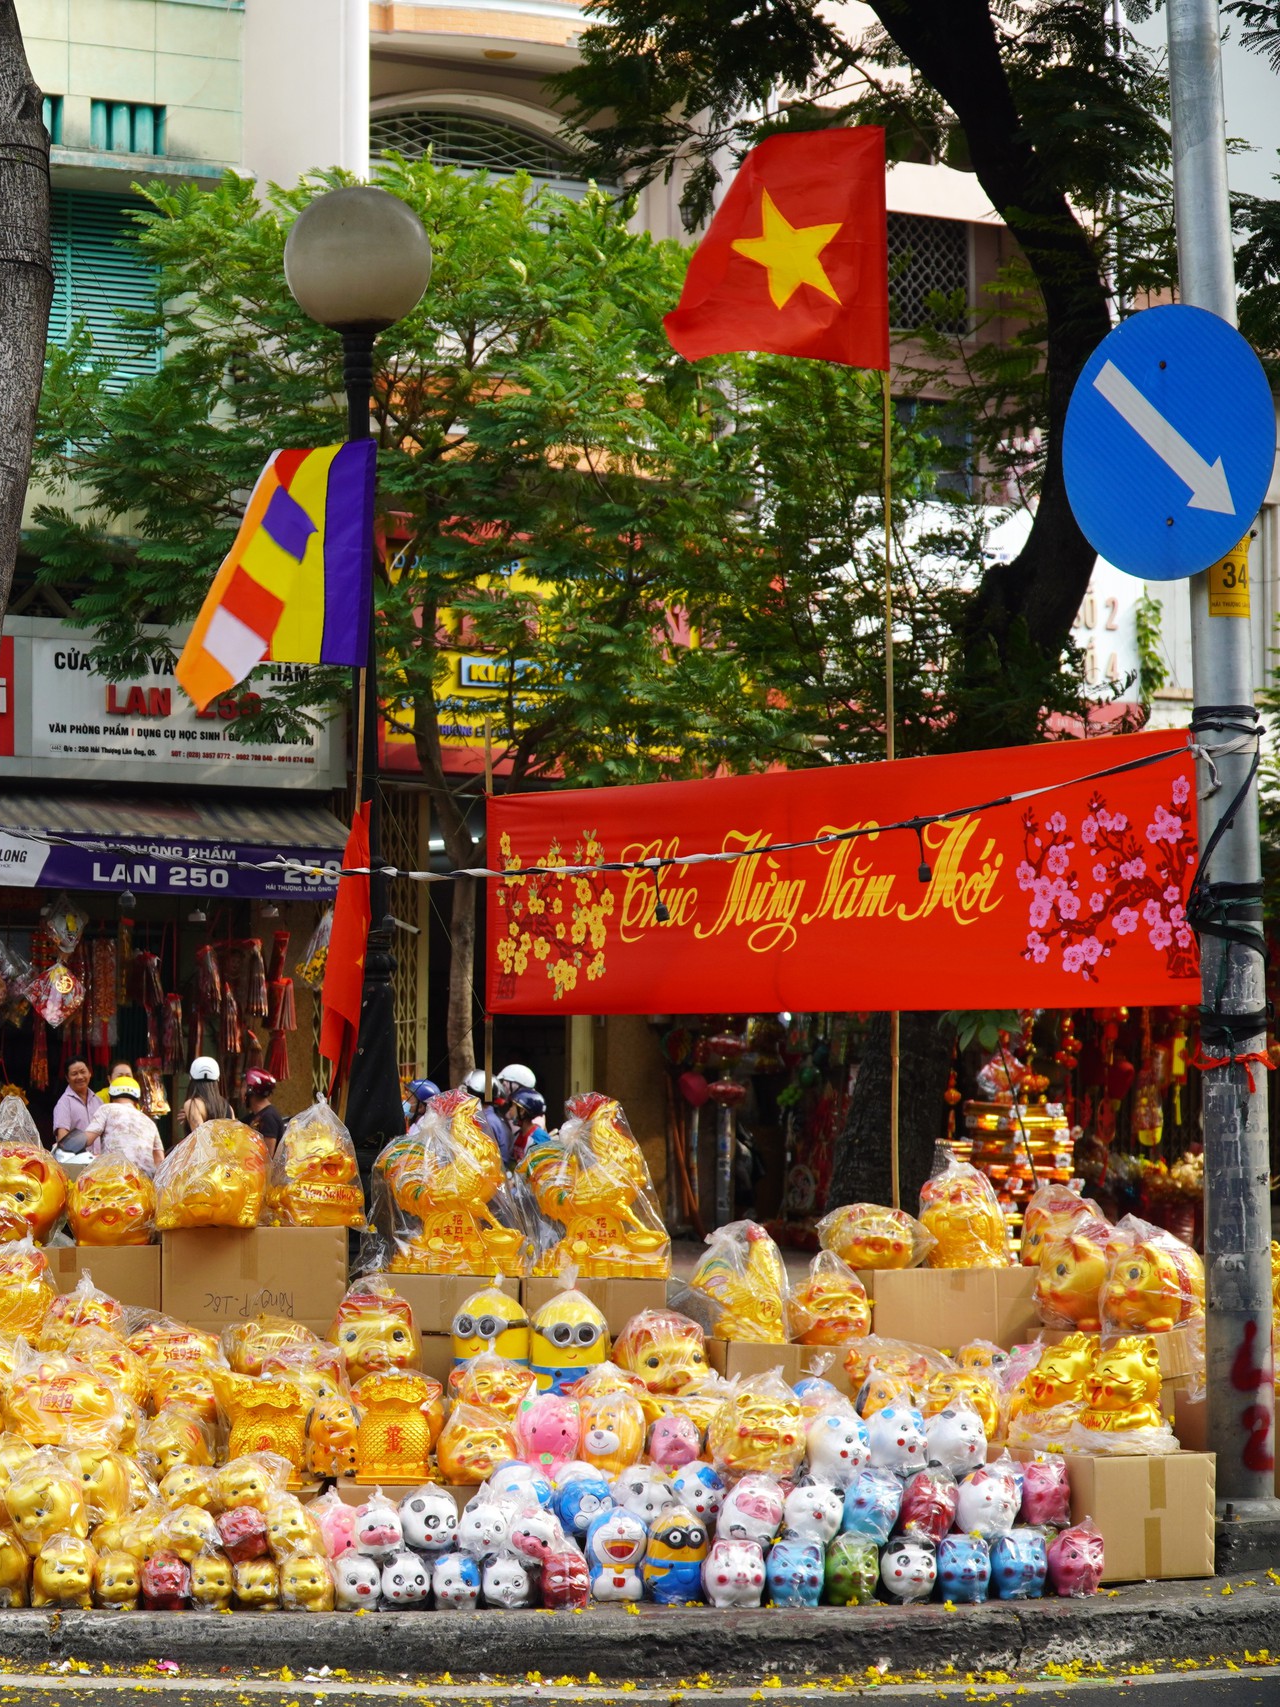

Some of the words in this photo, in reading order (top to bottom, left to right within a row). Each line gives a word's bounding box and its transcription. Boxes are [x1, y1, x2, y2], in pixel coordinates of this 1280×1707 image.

[1222, 561, 1248, 589] 34
[1105, 596, 1119, 631] 2
[54, 647, 92, 671] CỬA
[105, 684, 172, 717] LAN
[49, 723, 67, 733] VĂN
[69, 724, 100, 735] PHÒNG
[137, 728, 161, 739] DỤNG
[164, 729, 176, 740] CỤ
[179, 730, 197, 742] HỌC
[200, 731, 220, 741] SINH
[92, 862, 157, 885] LAN
[169, 866, 230, 889] 250
[620, 836, 699, 943] Chúc
[693, 829, 807, 953] Mừng
[801, 820, 899, 925] Năm
[897, 813, 1005, 926] Mới
